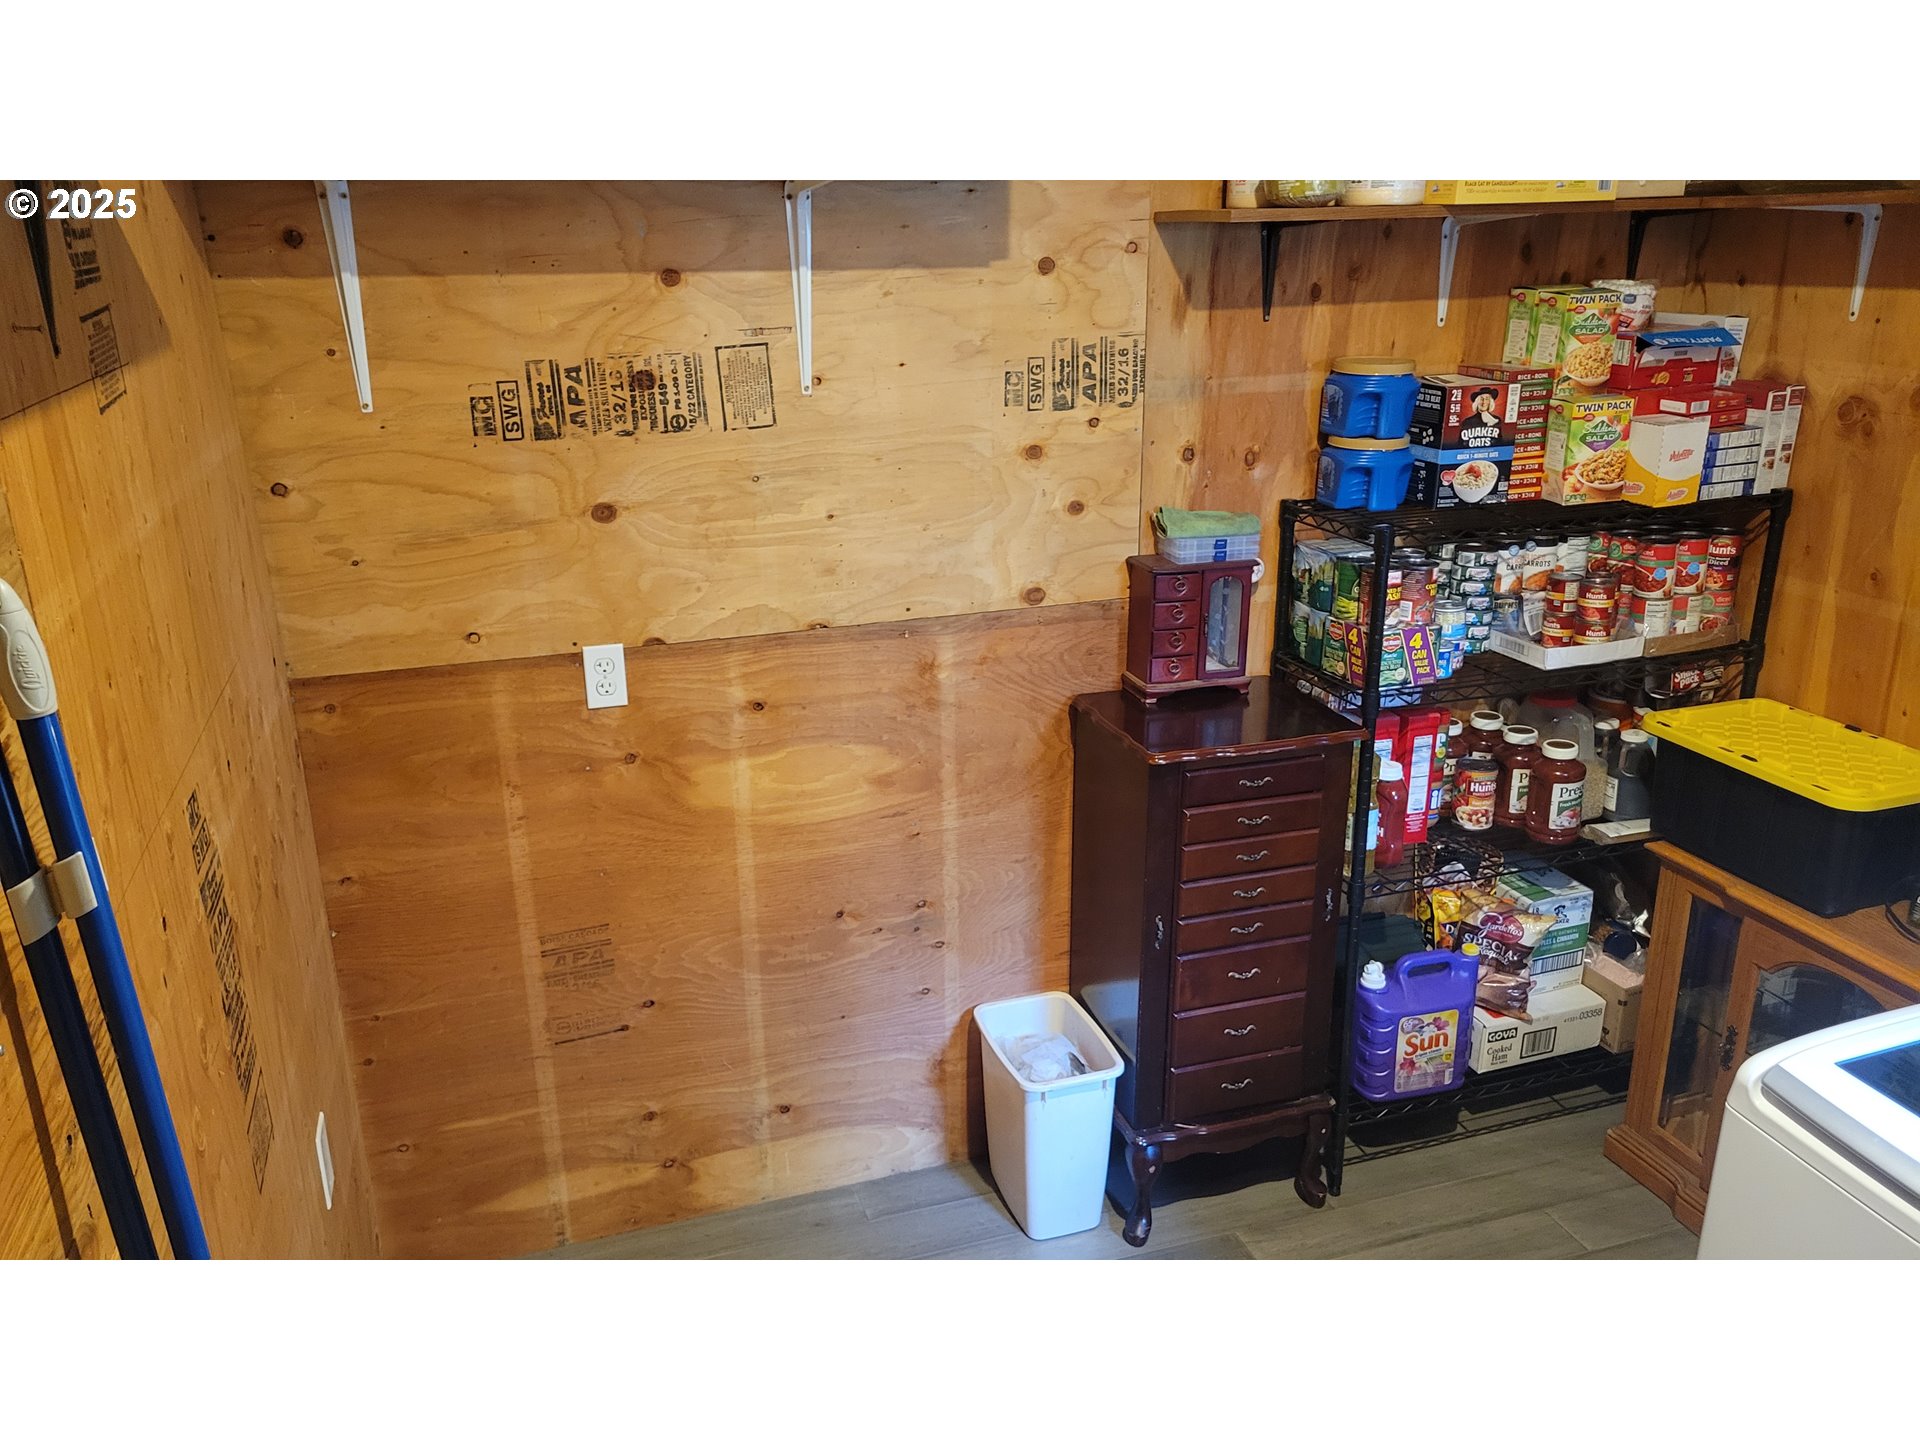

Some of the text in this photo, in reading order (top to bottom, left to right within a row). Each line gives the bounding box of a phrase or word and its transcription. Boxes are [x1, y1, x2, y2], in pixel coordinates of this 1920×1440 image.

[1570, 294, 1622, 304] TWIN PACK
[682, 355, 696, 401] CATEGORY
[1082, 343, 1097, 404] APA
[1030, 364, 1043, 404] SWG
[563, 364, 589, 430] APA
[501, 388, 520, 433] SWG
[1576, 400, 1632, 413] TWIN PACK
[1460, 426, 1500, 440] QUAKER
[1586, 434, 1615, 442] SALAD
[1468, 438, 1491, 448] OATS
[1524, 560, 1551, 568] CARROTS
[1348, 628, 1358, 644] 4
[1410, 632, 1423, 649] 4
[1412, 649, 1427, 660] CAN
[1414, 659, 1428, 667] VALUE
[1416, 666, 1430, 674] PACK
[1488, 1029, 1516, 1042] GOYA
[1404, 1032, 1449, 1057] Sun
[1486, 1044, 1512, 1055] Cooked
[1492, 1053, 1508, 1062] Ham
